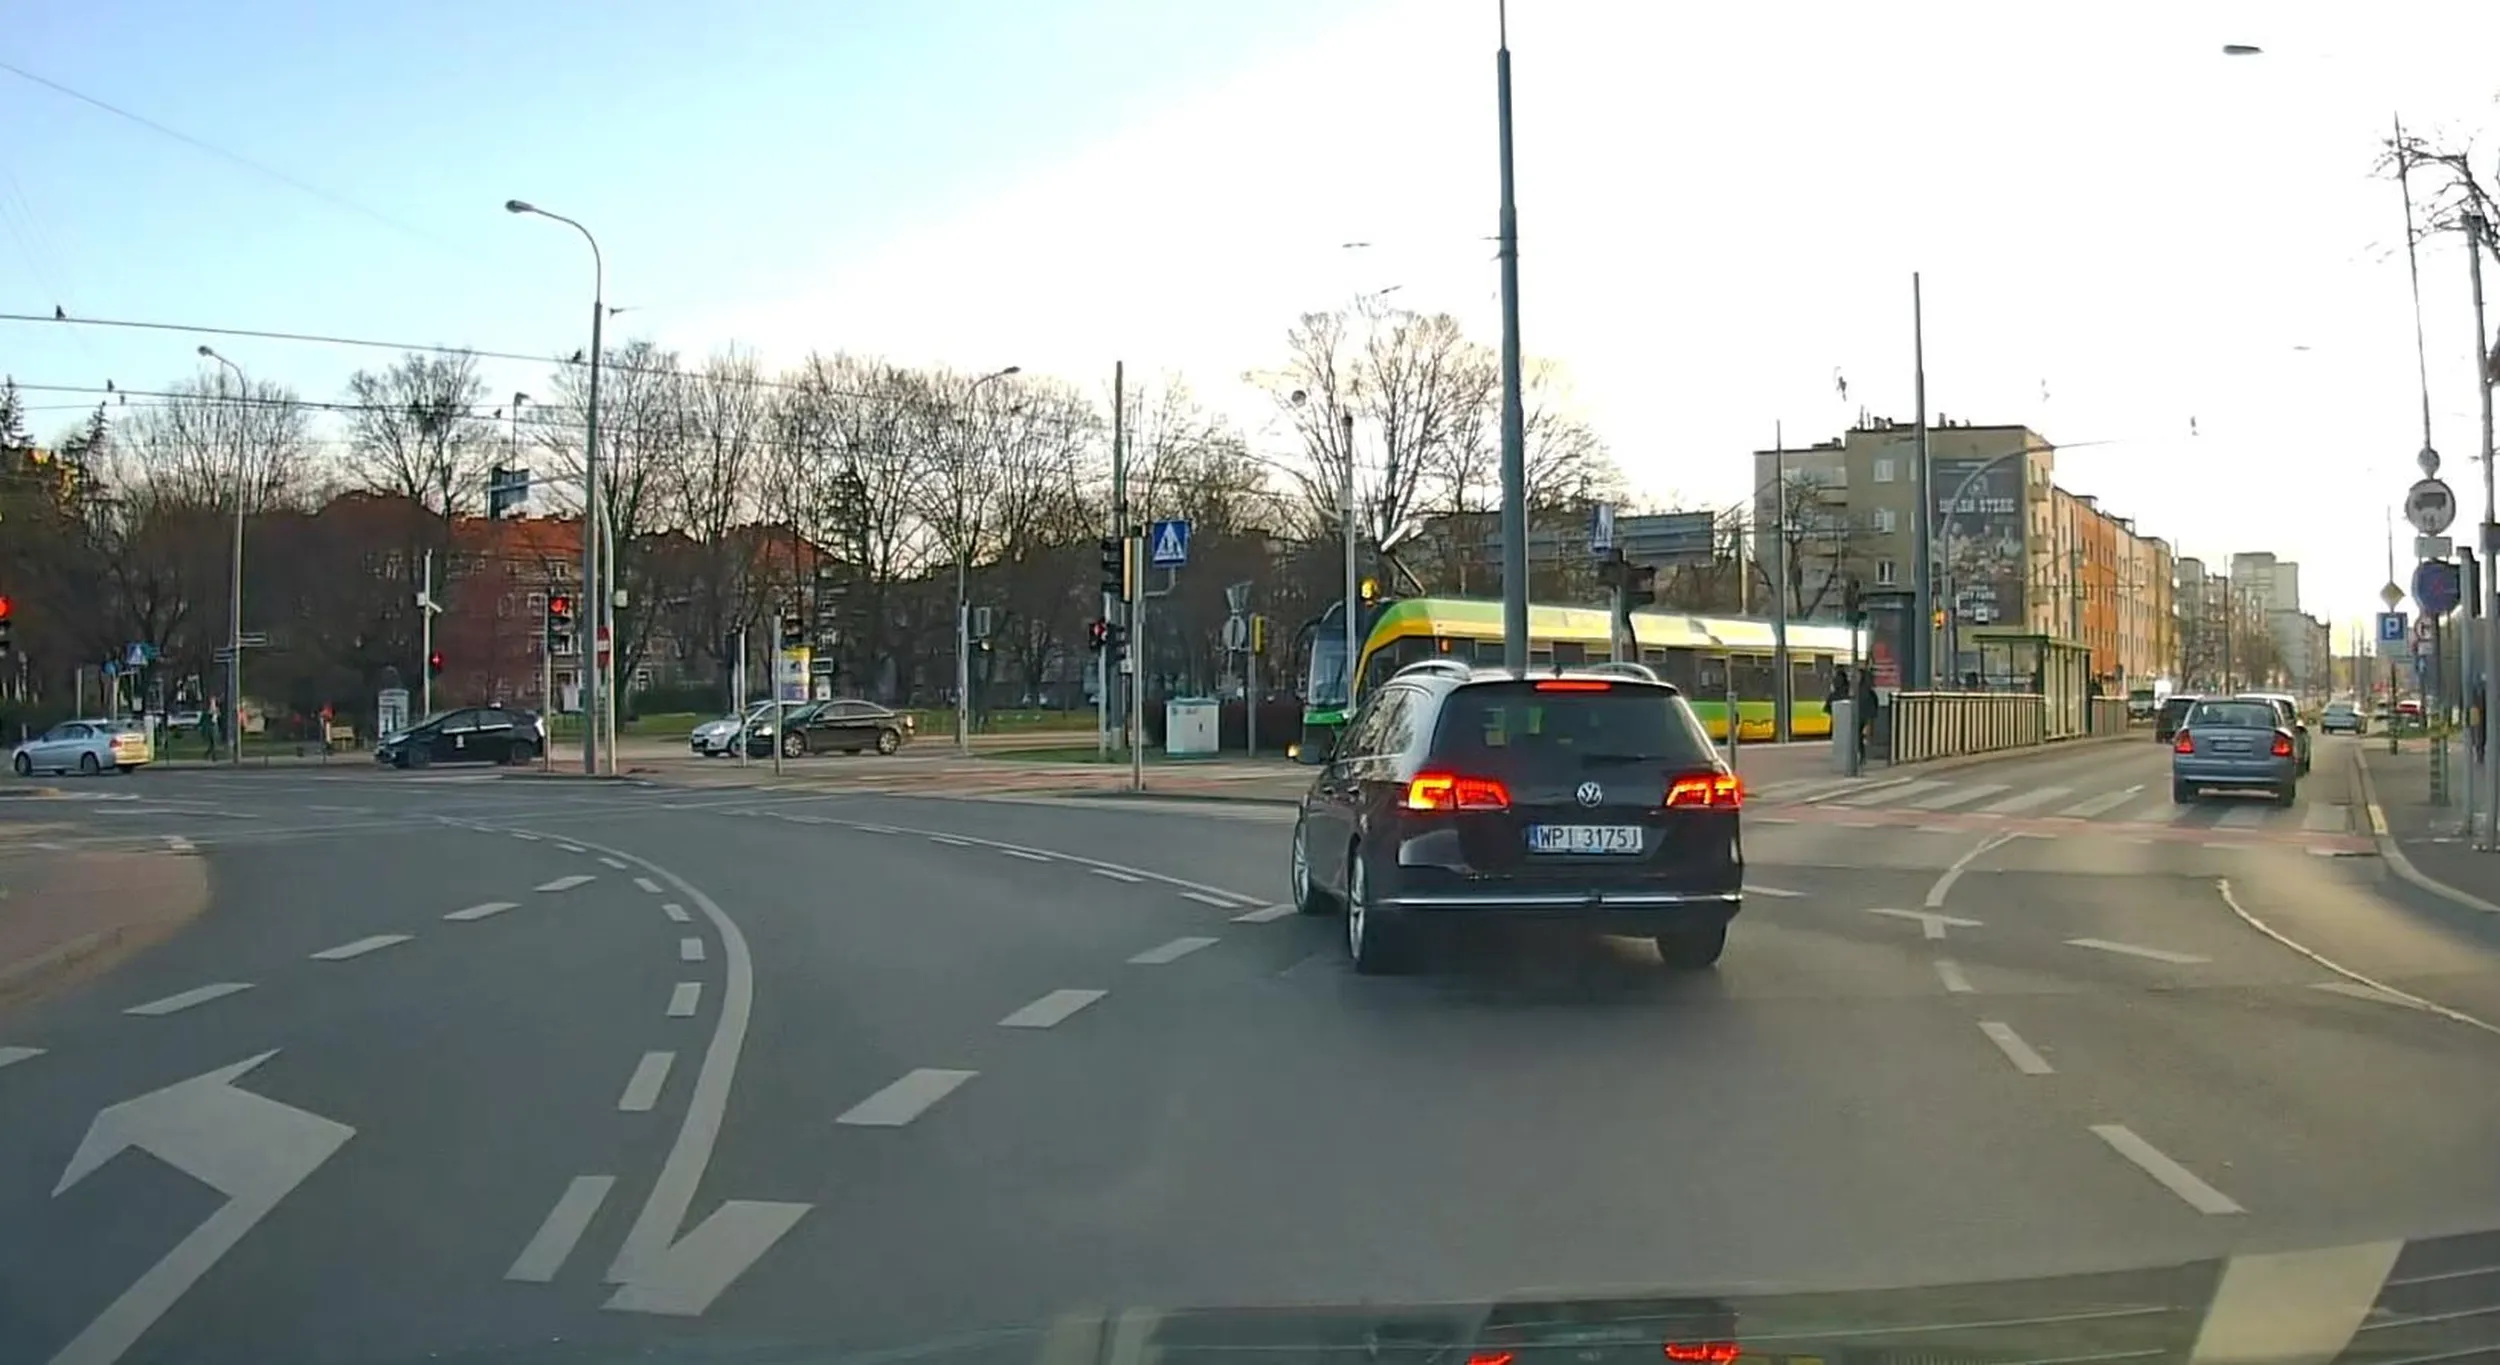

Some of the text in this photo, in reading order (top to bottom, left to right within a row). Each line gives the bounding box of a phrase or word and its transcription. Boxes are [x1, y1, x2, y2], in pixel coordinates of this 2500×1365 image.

[2385, 617, 2400, 638] P
[1540, 828, 1638, 848] WPI 3175J
